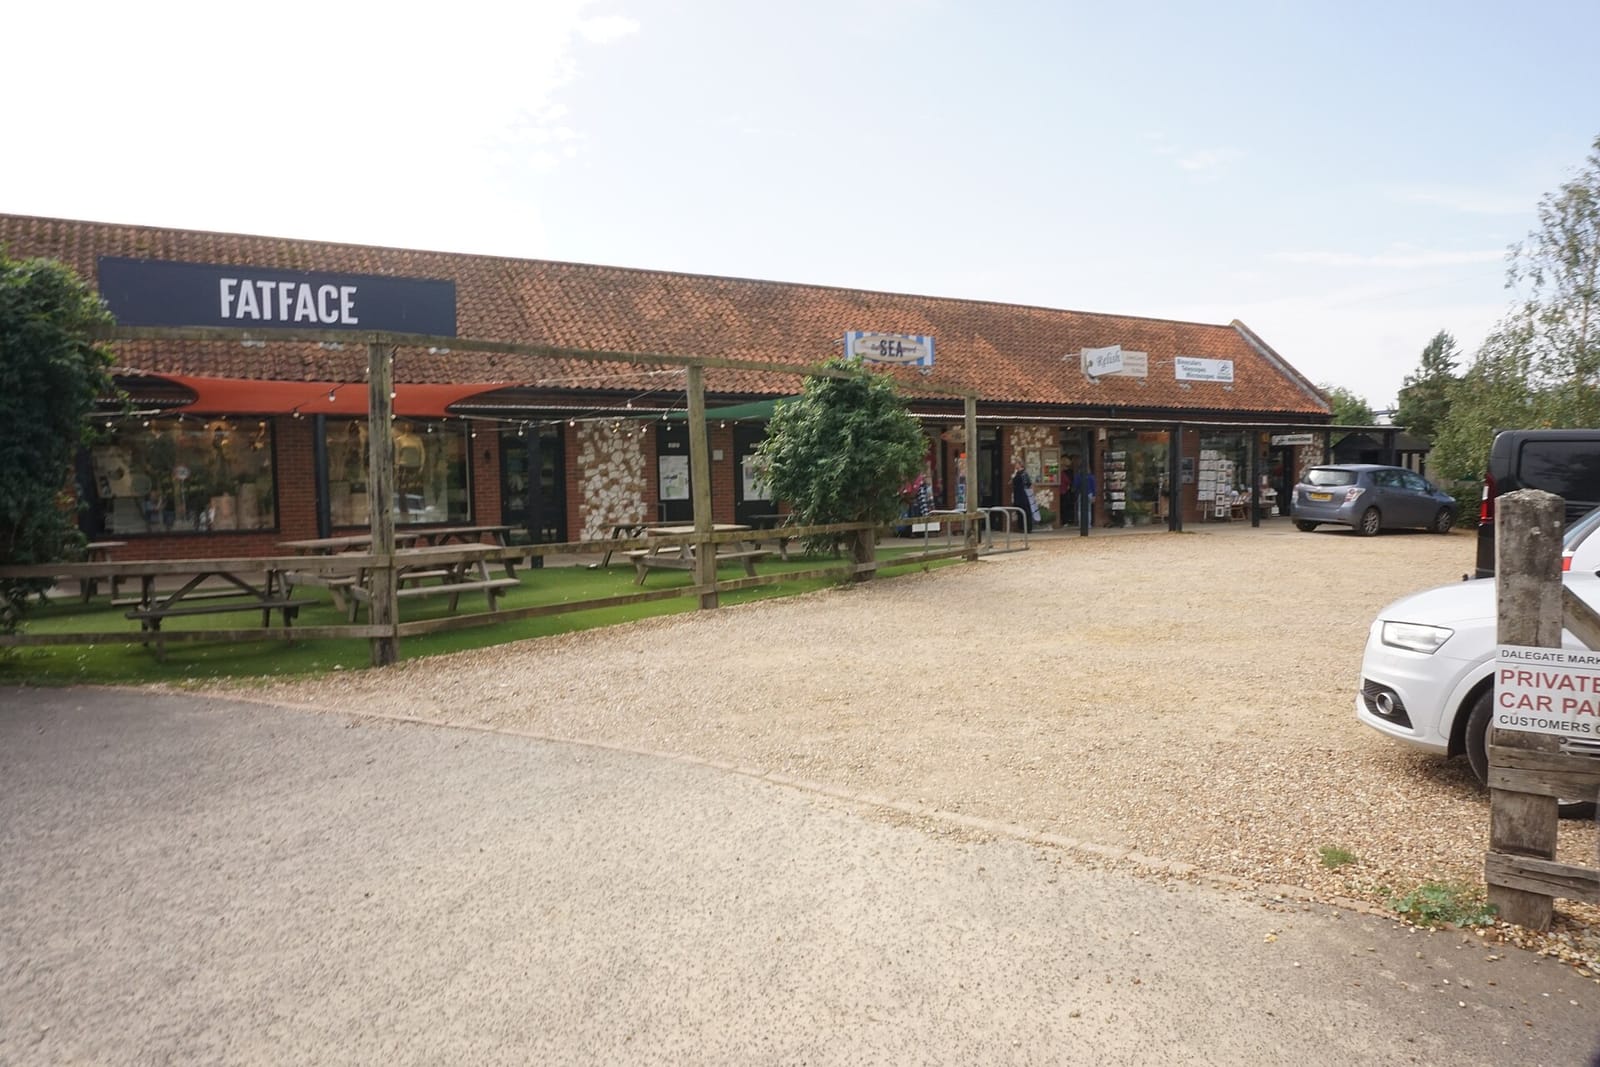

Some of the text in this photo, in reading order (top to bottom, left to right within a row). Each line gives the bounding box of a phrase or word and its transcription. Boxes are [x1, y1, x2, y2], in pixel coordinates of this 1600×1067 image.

[219, 277, 358, 325] FATFACE
[879, 339, 904, 358] SEA
[1501, 649, 1565, 662] DALEGATE
[1500, 669, 1600, 694] PRIVATE
[1499, 692, 1600, 718] CAR PA
[1499, 714, 1591, 734] CUSTOMERS
